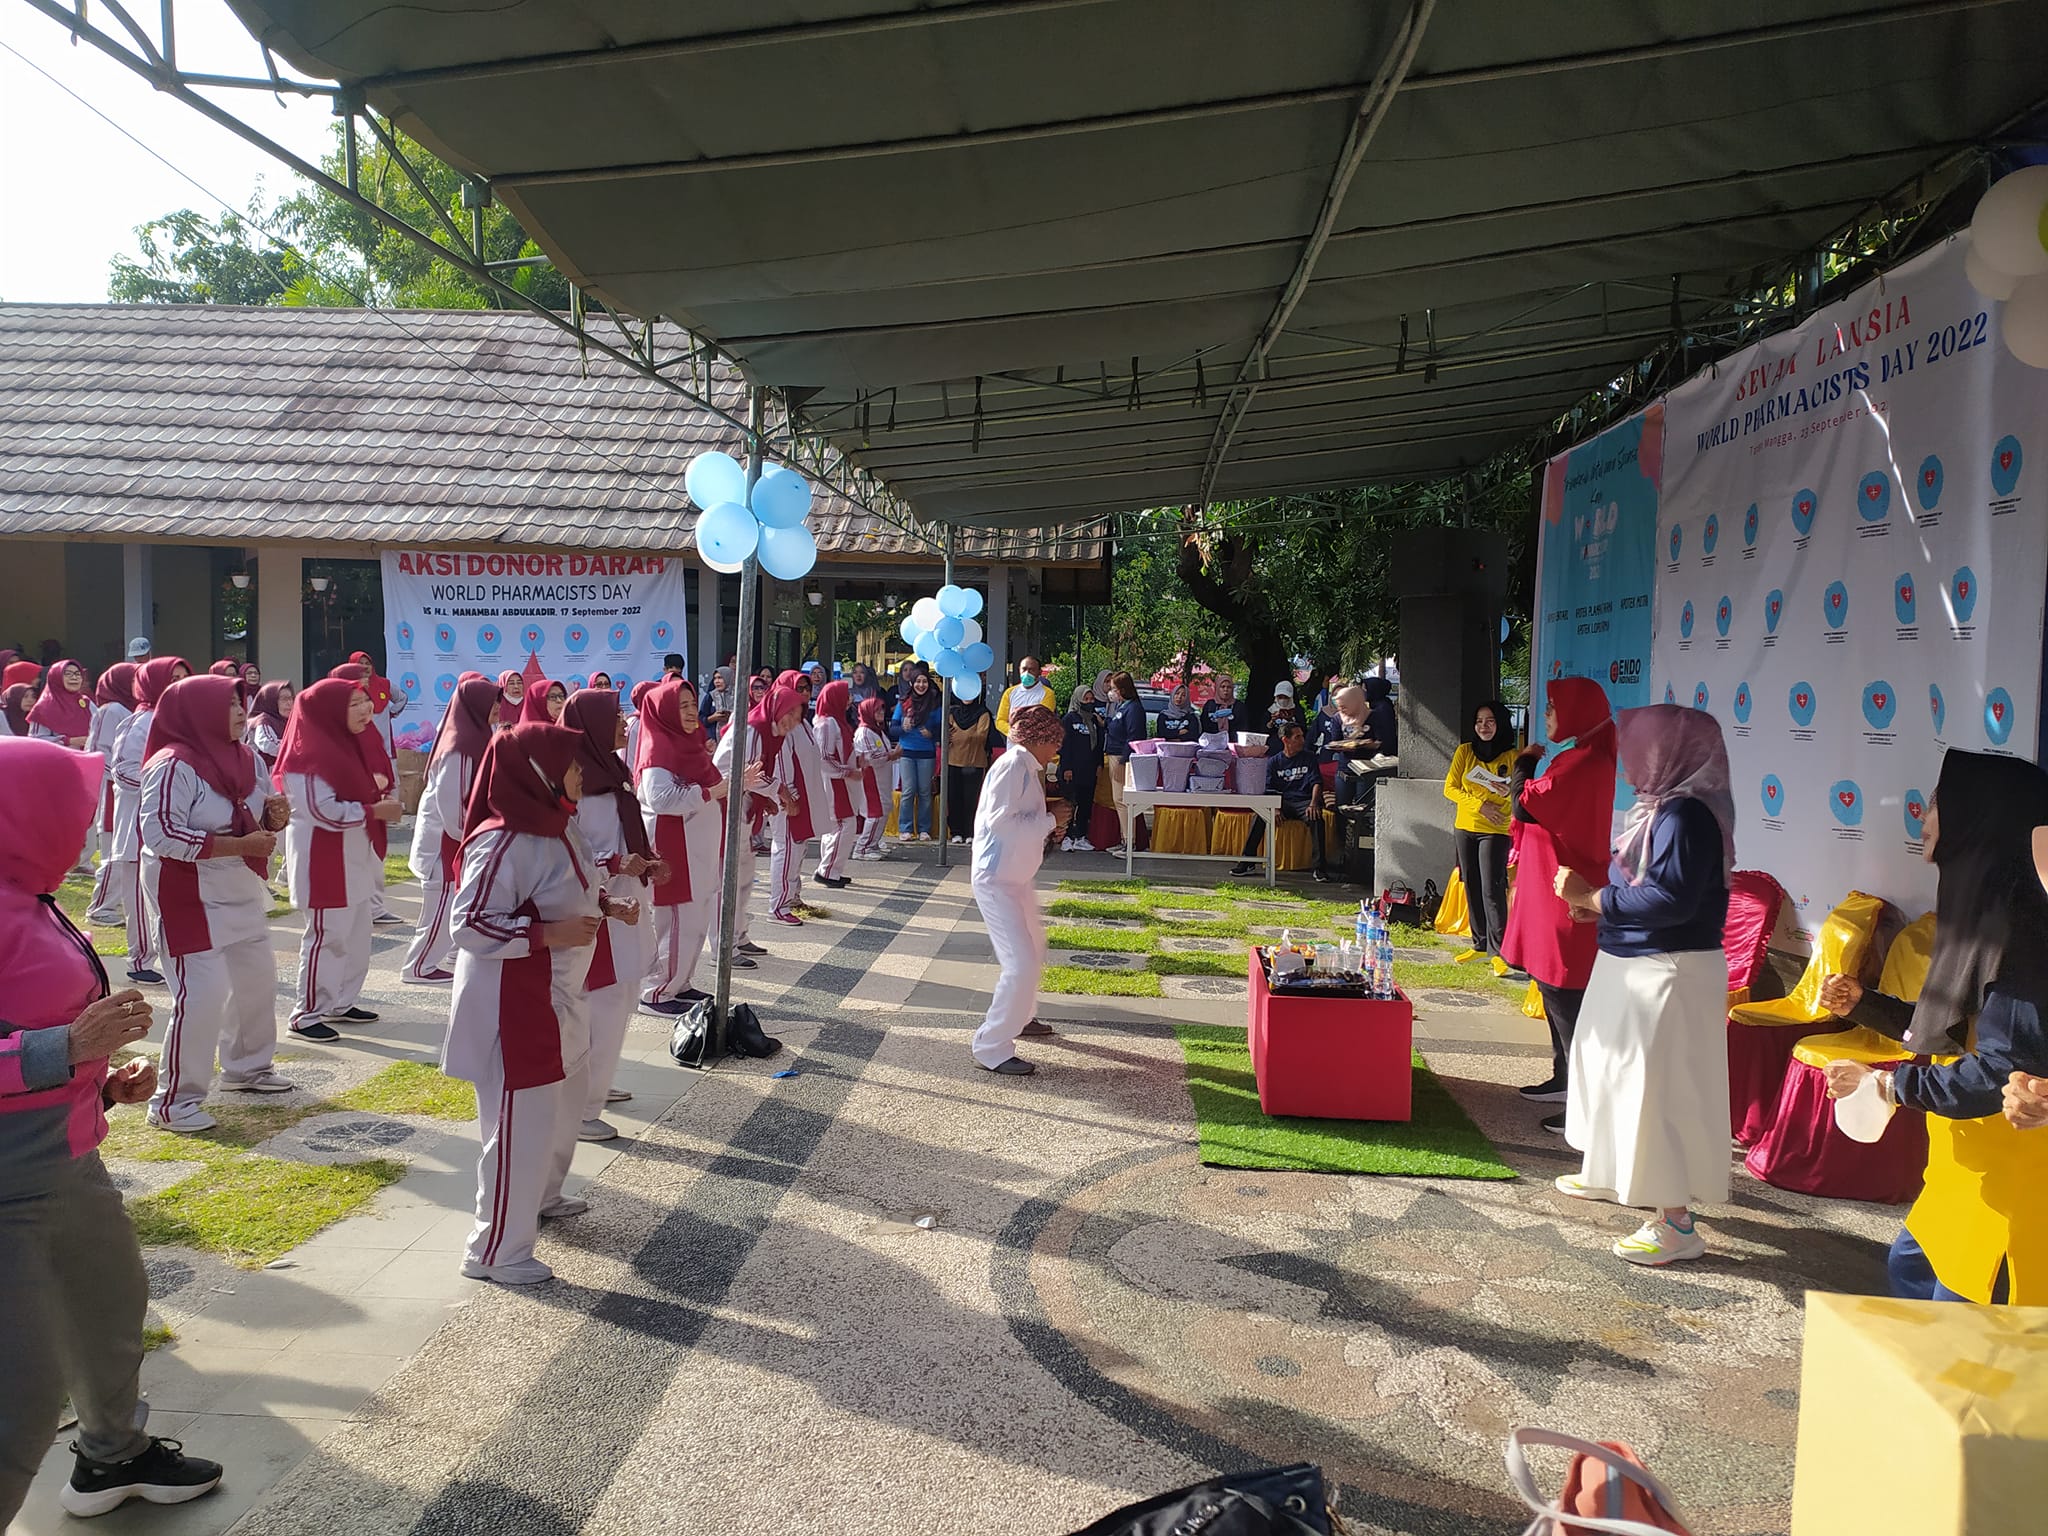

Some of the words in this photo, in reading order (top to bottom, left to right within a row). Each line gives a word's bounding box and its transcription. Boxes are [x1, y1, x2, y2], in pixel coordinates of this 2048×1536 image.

[1816, 295, 1911, 367] LANSIA
[1697, 417, 1739, 455] WORLD
[1743, 361, 1870, 436] PHARMACISTS
[1881, 340, 1919, 383] DAY
[1926, 311, 1988, 364] 2022
[1865, 401, 1888, 416] 202
[399, 553, 460, 576] AKSI
[467, 553, 562, 577] DONOR
[569, 554, 665, 577] DARAH
[431, 585, 486, 601] WORLD
[492, 584, 597, 601] PHARMACISTS
[602, 584, 632, 600] DAY
[452, 608, 499, 617] MANAMBAI
[560, 607, 569, 616] 17
[571, 607, 619, 617] September
[622, 606, 641, 616] 2022
[1619, 659, 1641, 675] ENDO
[1277, 766, 1308, 777] WORLD
